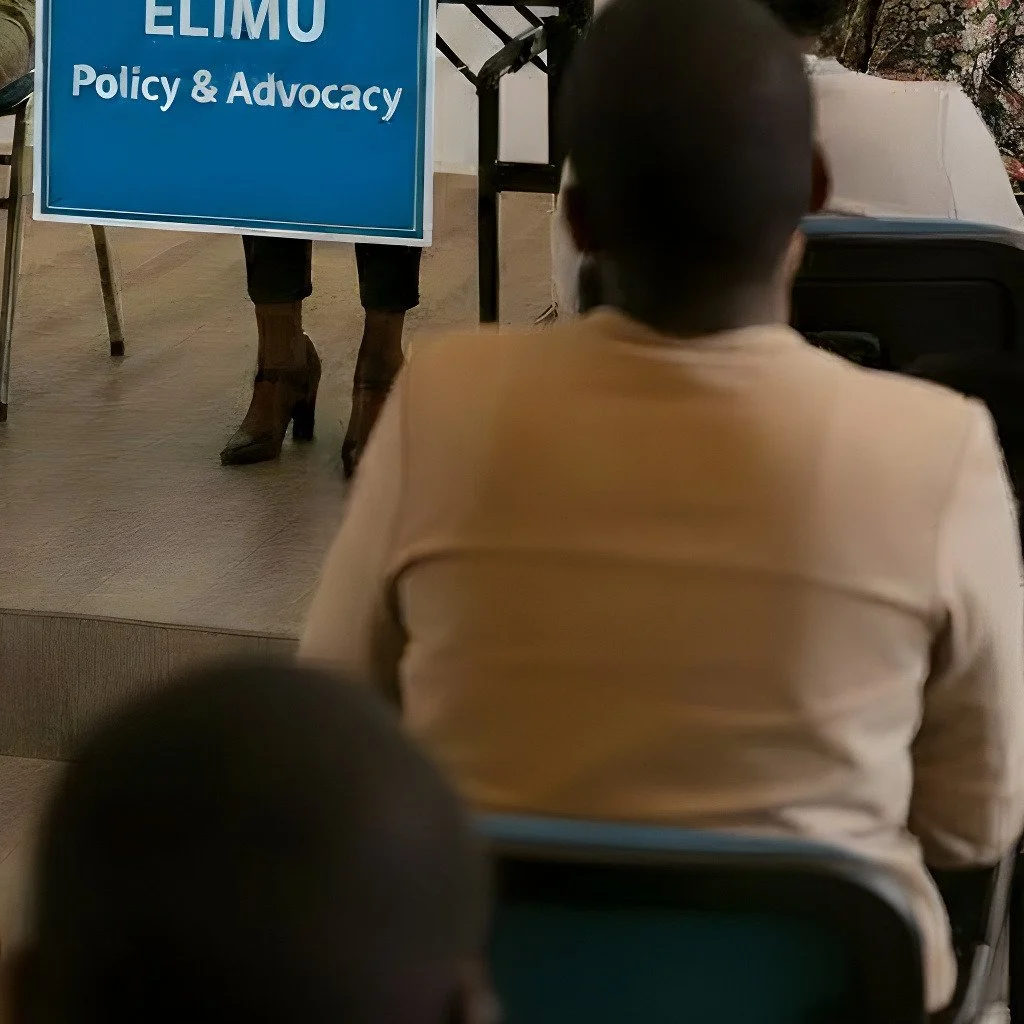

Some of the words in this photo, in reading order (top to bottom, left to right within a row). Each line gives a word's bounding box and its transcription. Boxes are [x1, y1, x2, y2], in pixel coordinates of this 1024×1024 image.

[72, 63, 181, 112] Policy
[190, 69, 218, 103] &
[225, 71, 403, 122] Advocacy
